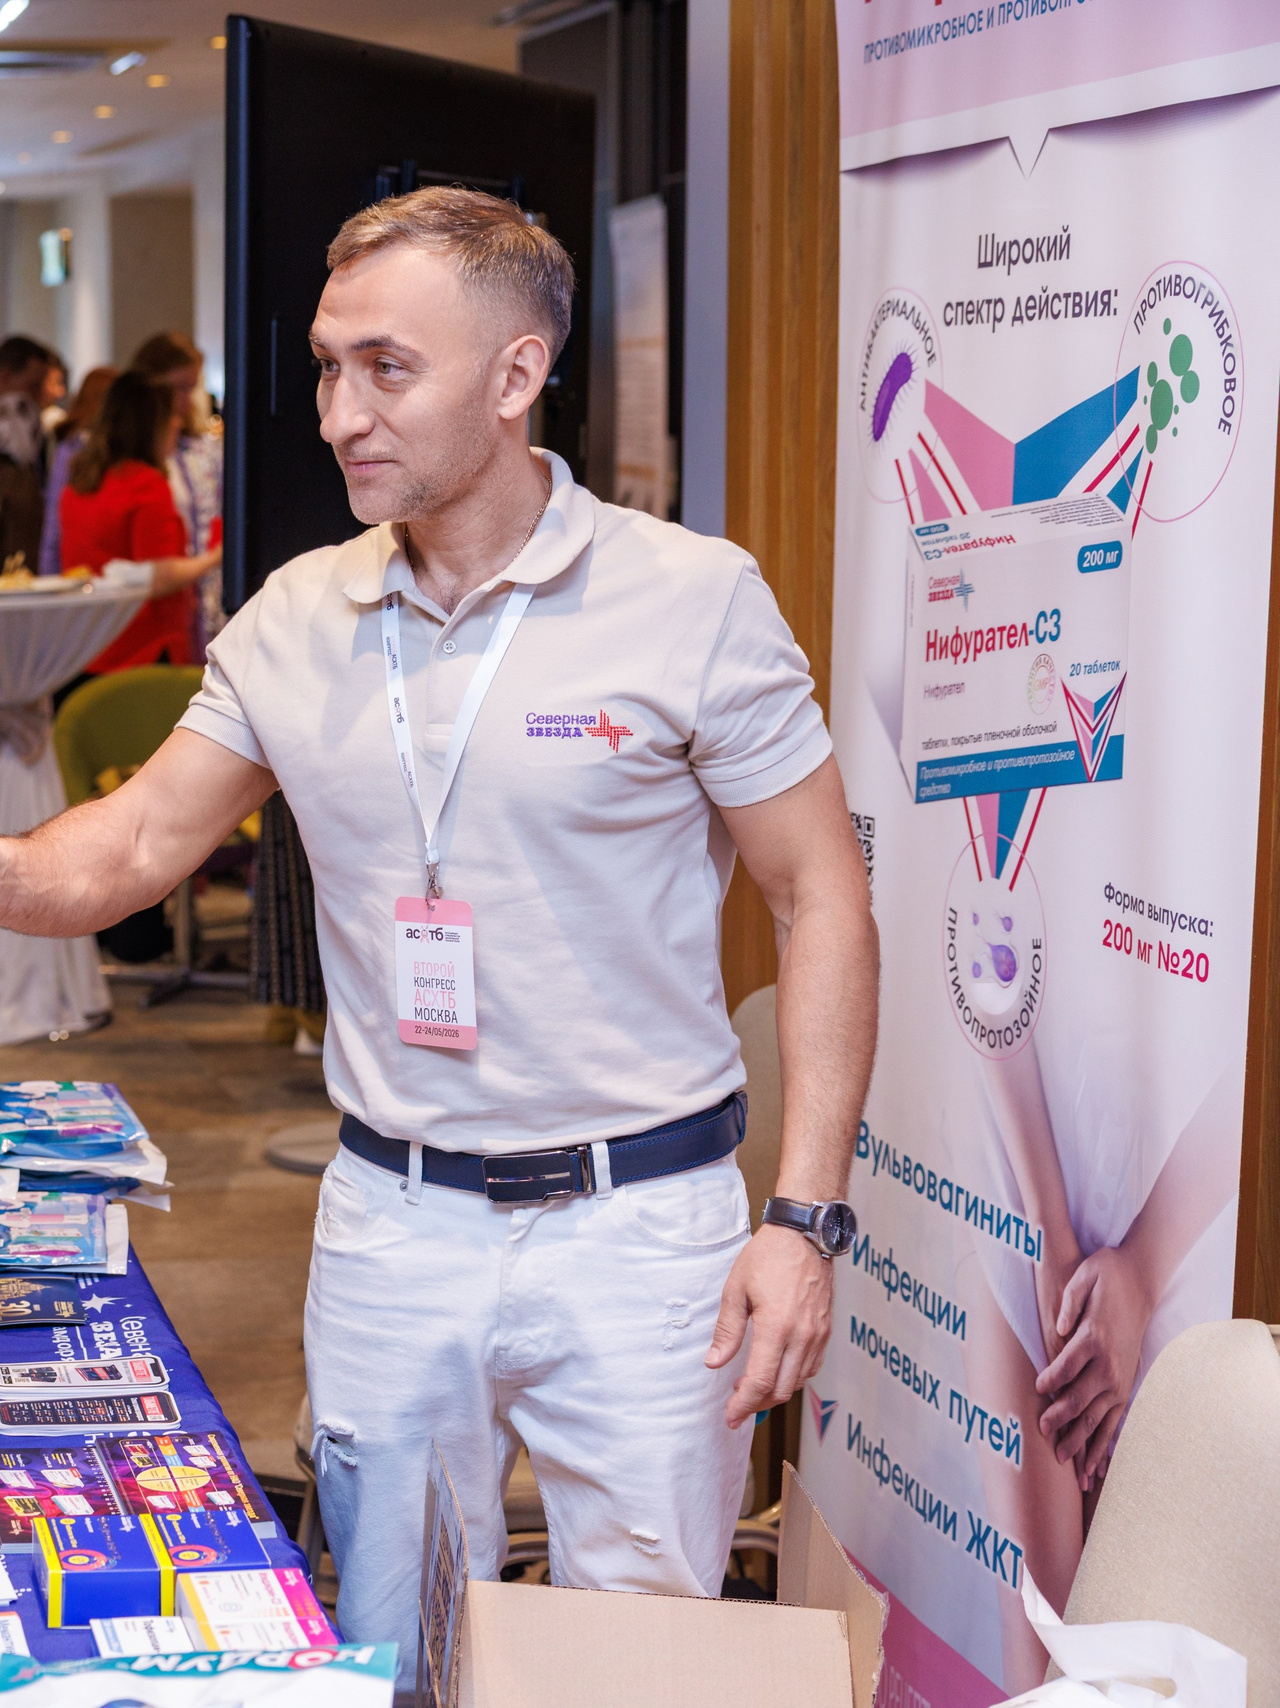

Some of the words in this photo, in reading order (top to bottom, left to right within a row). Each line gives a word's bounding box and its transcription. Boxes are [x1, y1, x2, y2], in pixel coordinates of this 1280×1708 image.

[863, 10, 983, 64] ПРОТИВОМИКРОБНОЕ
[986, 6, 995, 29] И
[977, 225, 1071, 276] Широкий
[943, 294, 1005, 333] спектр
[1011, 286, 1119, 327] действия:
[1133, 273, 1237, 436] ПРОТИВОГРИБКОВОЕ
[1083, 549, 1104, 569] 200
[1106, 549, 1119, 565] мг
[1070, 662, 1082, 678] 20
[1083, 658, 1121, 675] таблеток
[525, 712, 597, 727] Северная
[1104, 882, 1145, 917] Форма
[1147, 903, 1214, 938] выпуска:
[413, 961, 455, 978] ВТОРОЙ
[1102, 919, 1134, 955] 200
[1137, 939, 1153, 963] мг
[1158, 943, 1210, 983] №20
[414, 976, 456, 991] КОНГРЕСС
[414, 988, 456, 1009] АСХТБ
[947, 906, 1043, 1050] ПРОТИВОПРОТОЗОЙНОЕ
[414, 1006, 458, 1024] МОСКВА
[414, 1025, 460, 1038] 22-24/05/2026
[856, 1120, 1044, 1262] Вульвовагиниты
[852, 1233, 967, 1342] Инфекции
[850, 1315, 939, 1410] мочевых
[950, 1387, 1022, 1466] путей
[847, 1412, 958, 1542] Инфекции
[966, 1509, 1024, 1590] ЖКТ
